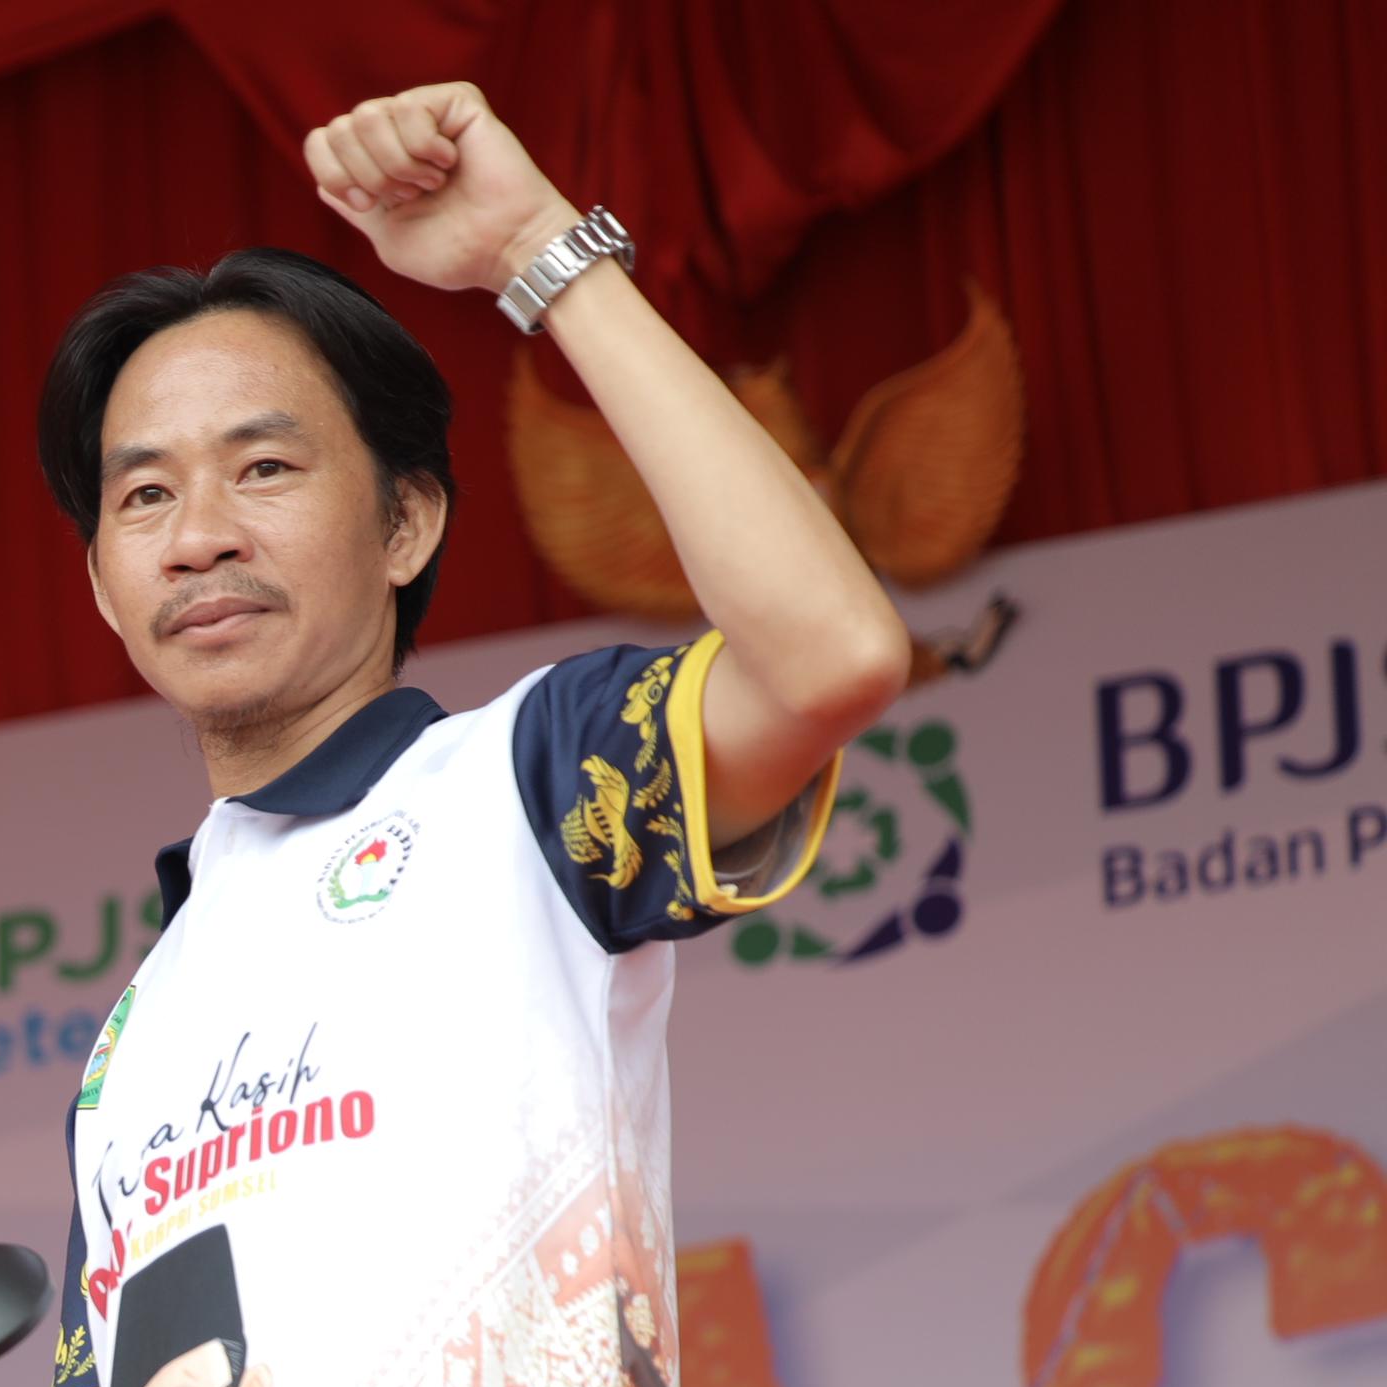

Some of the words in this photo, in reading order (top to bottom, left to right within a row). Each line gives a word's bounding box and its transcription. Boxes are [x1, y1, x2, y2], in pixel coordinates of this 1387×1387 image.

[1096, 636, 1387, 812] BPJ
[1103, 829, 1325, 908] Badan
[143, 1090, 376, 1216] Supriono
